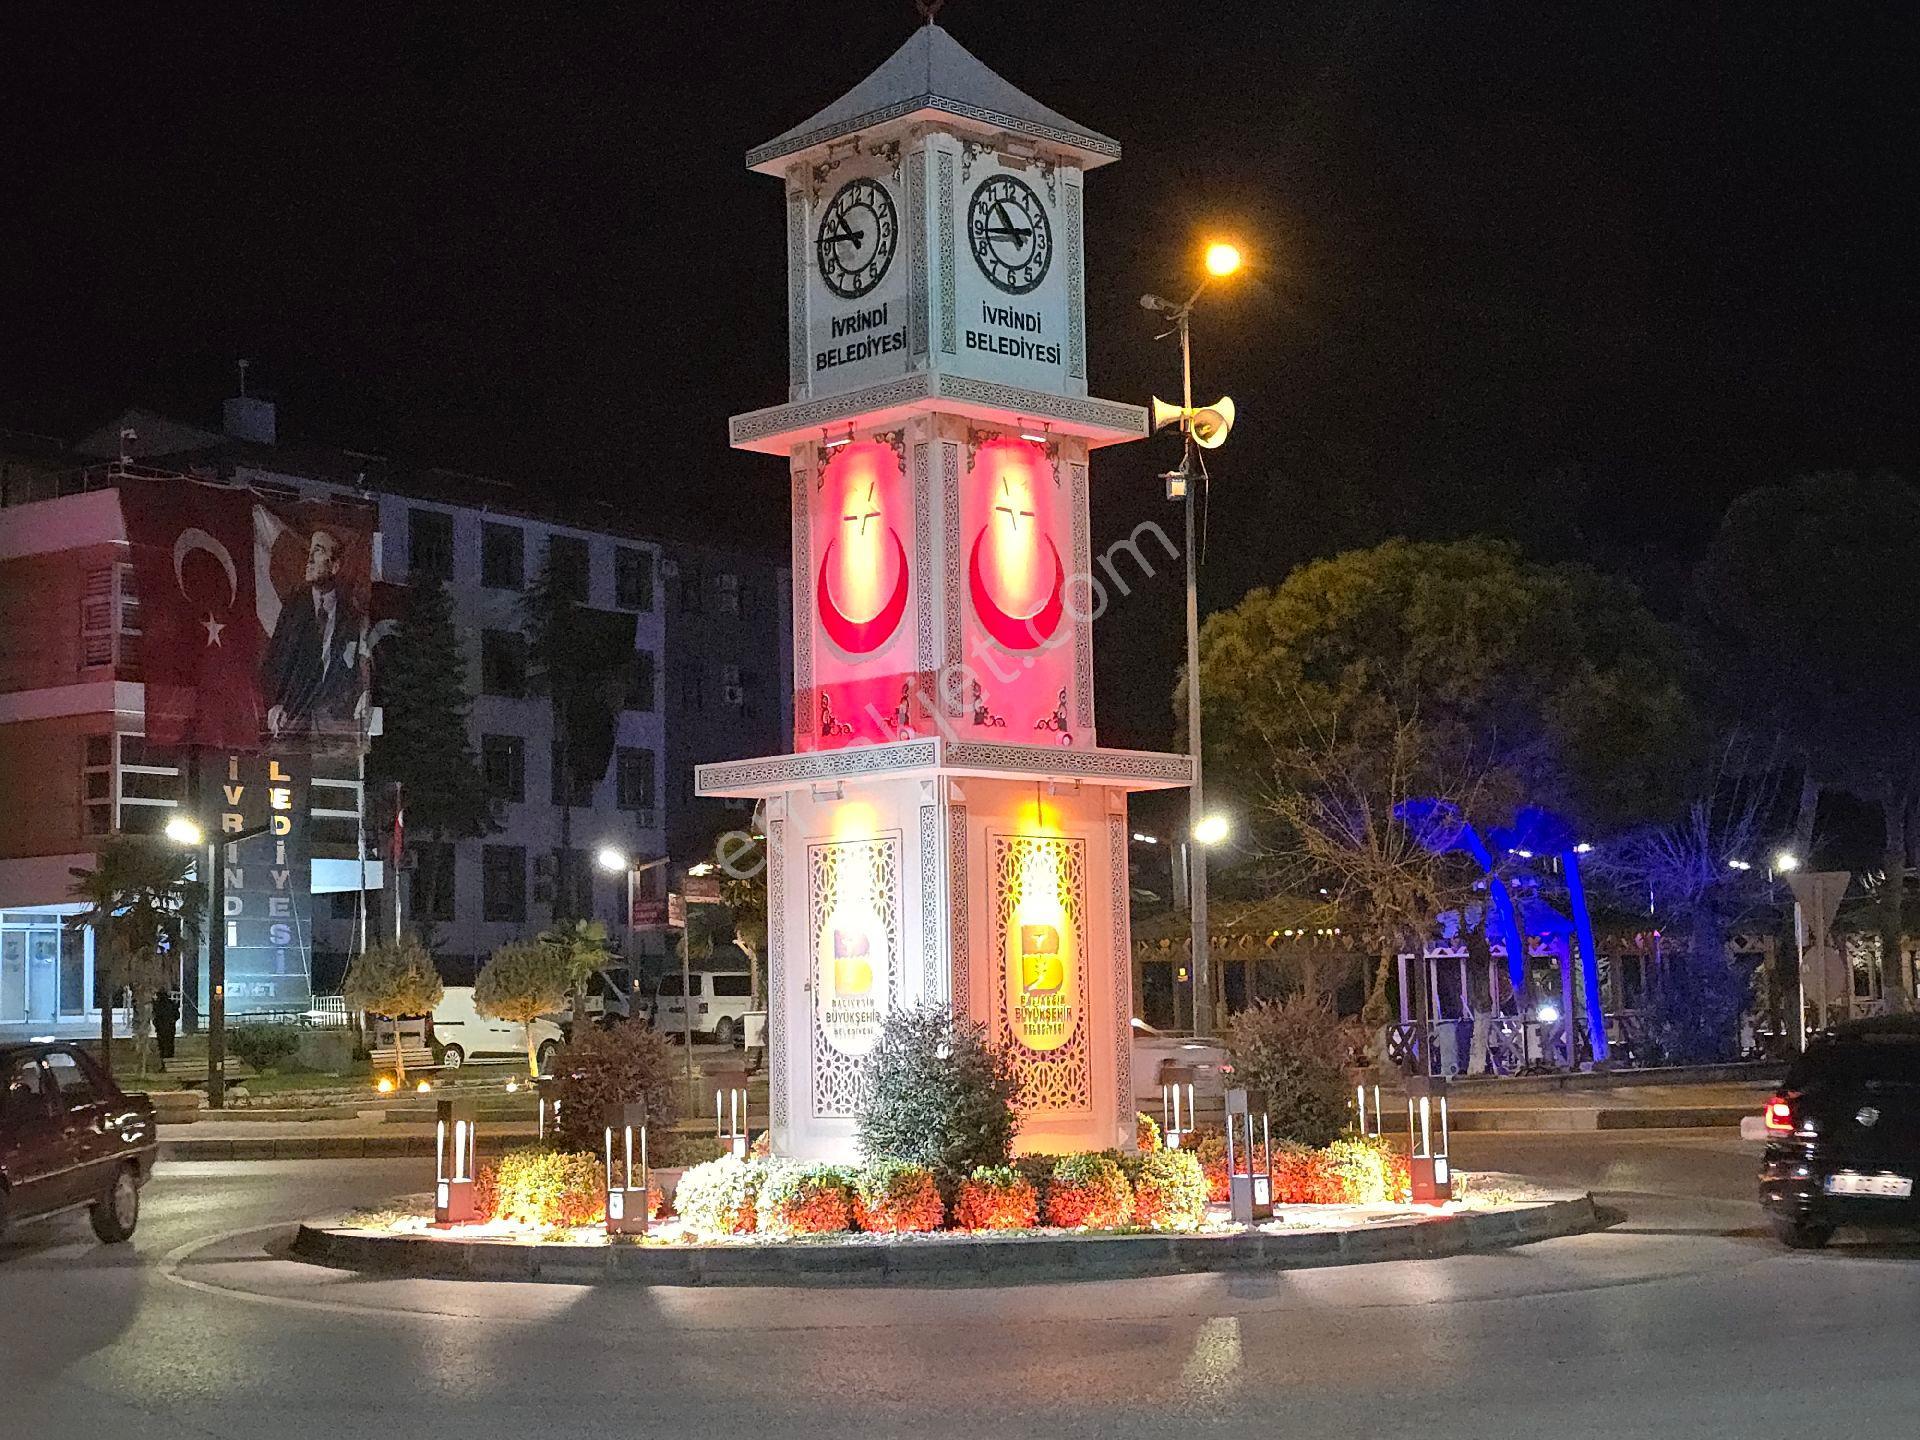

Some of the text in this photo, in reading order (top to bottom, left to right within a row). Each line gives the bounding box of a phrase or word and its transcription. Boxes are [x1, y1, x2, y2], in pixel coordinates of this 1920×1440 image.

[849, 186, 862, 204] 12
[868, 188, 875, 206] 1
[986, 186, 997, 202] 11
[1002, 181, 1016, 201] 12
[975, 201, 988, 215] 10
[1022, 192, 1030, 212] 1
[879, 203, 889, 219] 2
[882, 222, 891, 238] 3
[974, 219, 985, 235] 9
[1033, 213, 1043, 230] 2
[824, 241, 831, 256] 9
[878, 240, 887, 257] 4
[979, 240, 988, 256] 8
[1038, 233, 1046, 250] 3
[827, 259, 835, 274] 8
[990, 259, 999, 276] 7
[1033, 252, 1043, 267] 4
[837, 272, 846, 289] 7
[853, 273, 862, 289] 6
[1007, 269, 1017, 285] 6
[1024, 266, 1033, 282] 5
[832, 302, 888, 339] İVRİNDİ
[983, 300, 1041, 334] İVRİNDİ
[816, 325, 908, 371] BELEDİYESİ
[966, 330, 1061, 365] BELEDİYESİ
